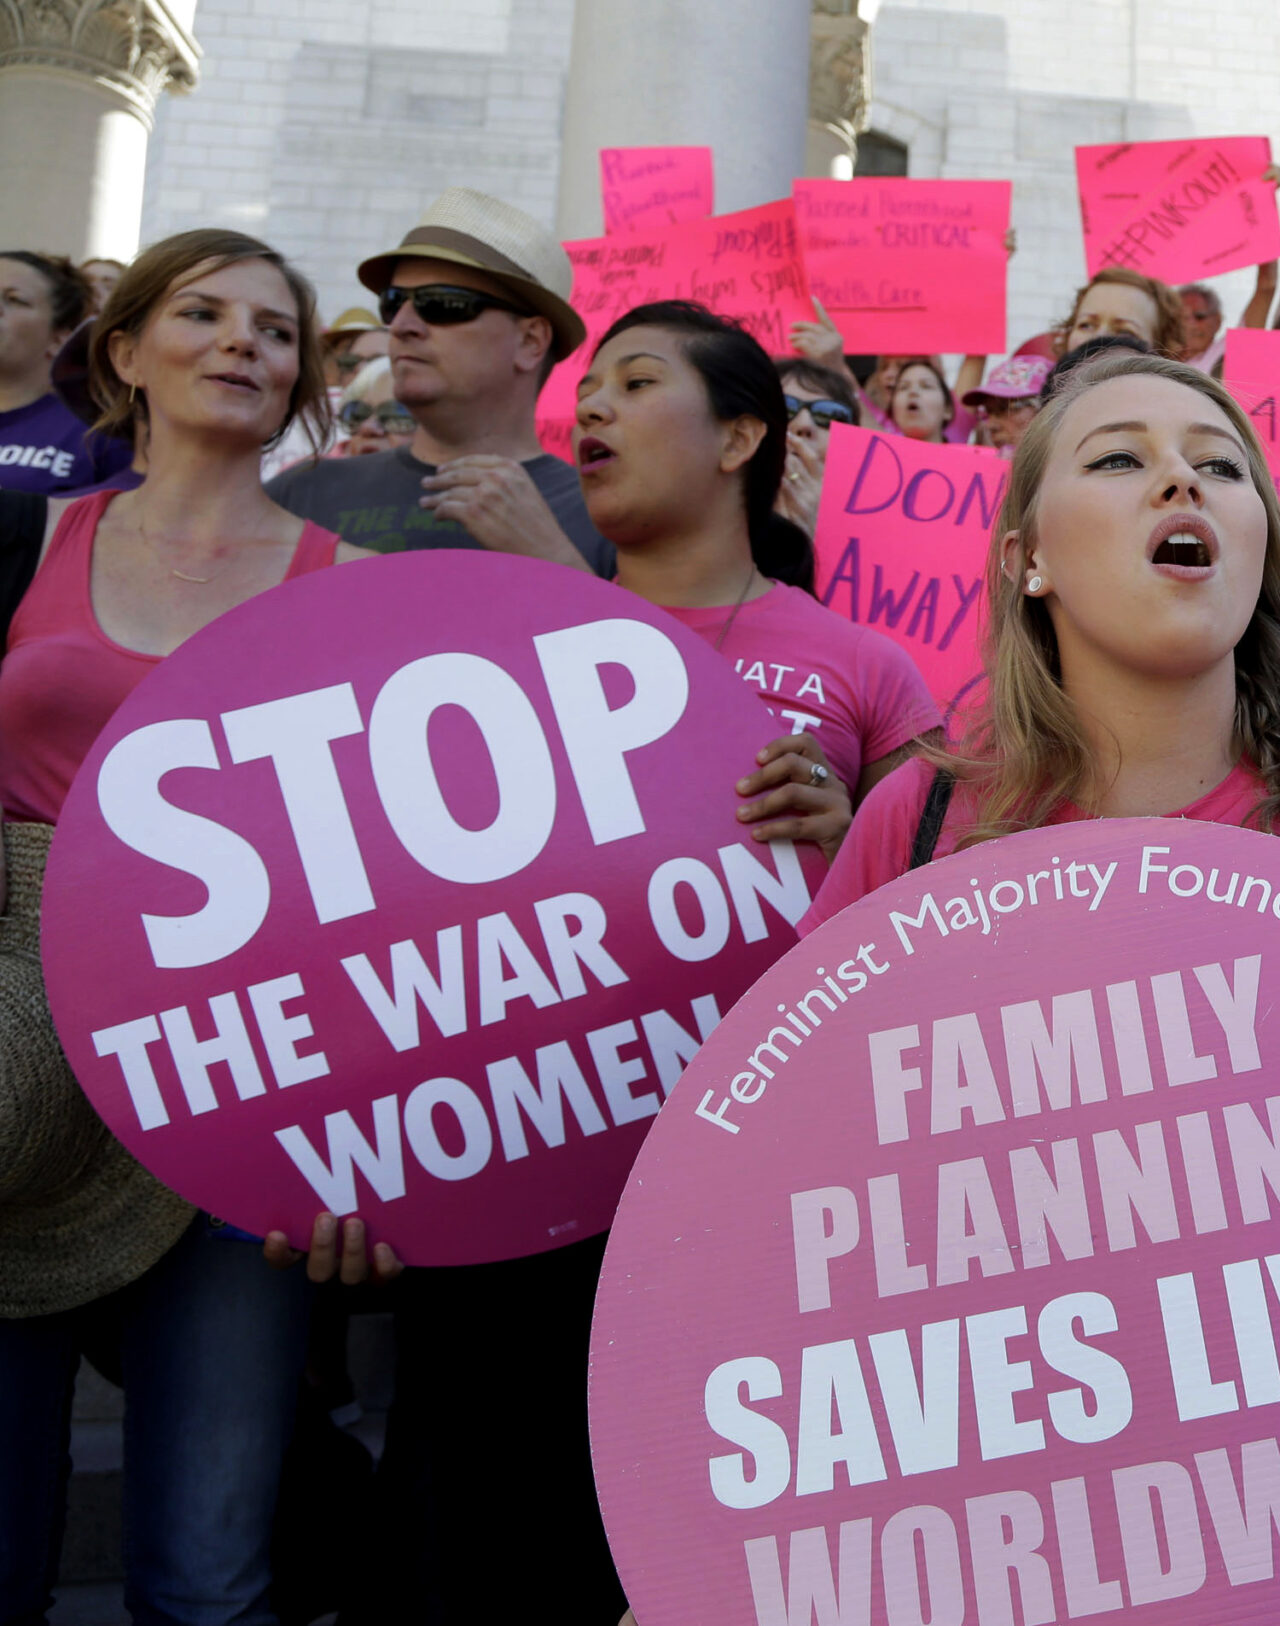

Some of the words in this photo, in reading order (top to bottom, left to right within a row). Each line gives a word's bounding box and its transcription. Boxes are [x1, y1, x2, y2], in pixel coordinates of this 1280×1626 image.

[1100, 150, 1242, 266] #PINKOUT!
[0, 444, 75, 478] OICE
[734, 657, 795, 692] AT
[796, 673, 826, 704] A
[822, 536, 984, 652] AWAY
[97, 617, 690, 969] STOP
[91, 972, 331, 1132] THE
[339, 891, 630, 1053] WAR
[647, 838, 812, 962] ON
[695, 943, 890, 1135] Feminist
[888, 856, 1119, 955] Majority
[868, 954, 1263, 1146] FAMILY
[274, 993, 722, 1217] WOMEN
[703, 1290, 1134, 1511] SAVES
